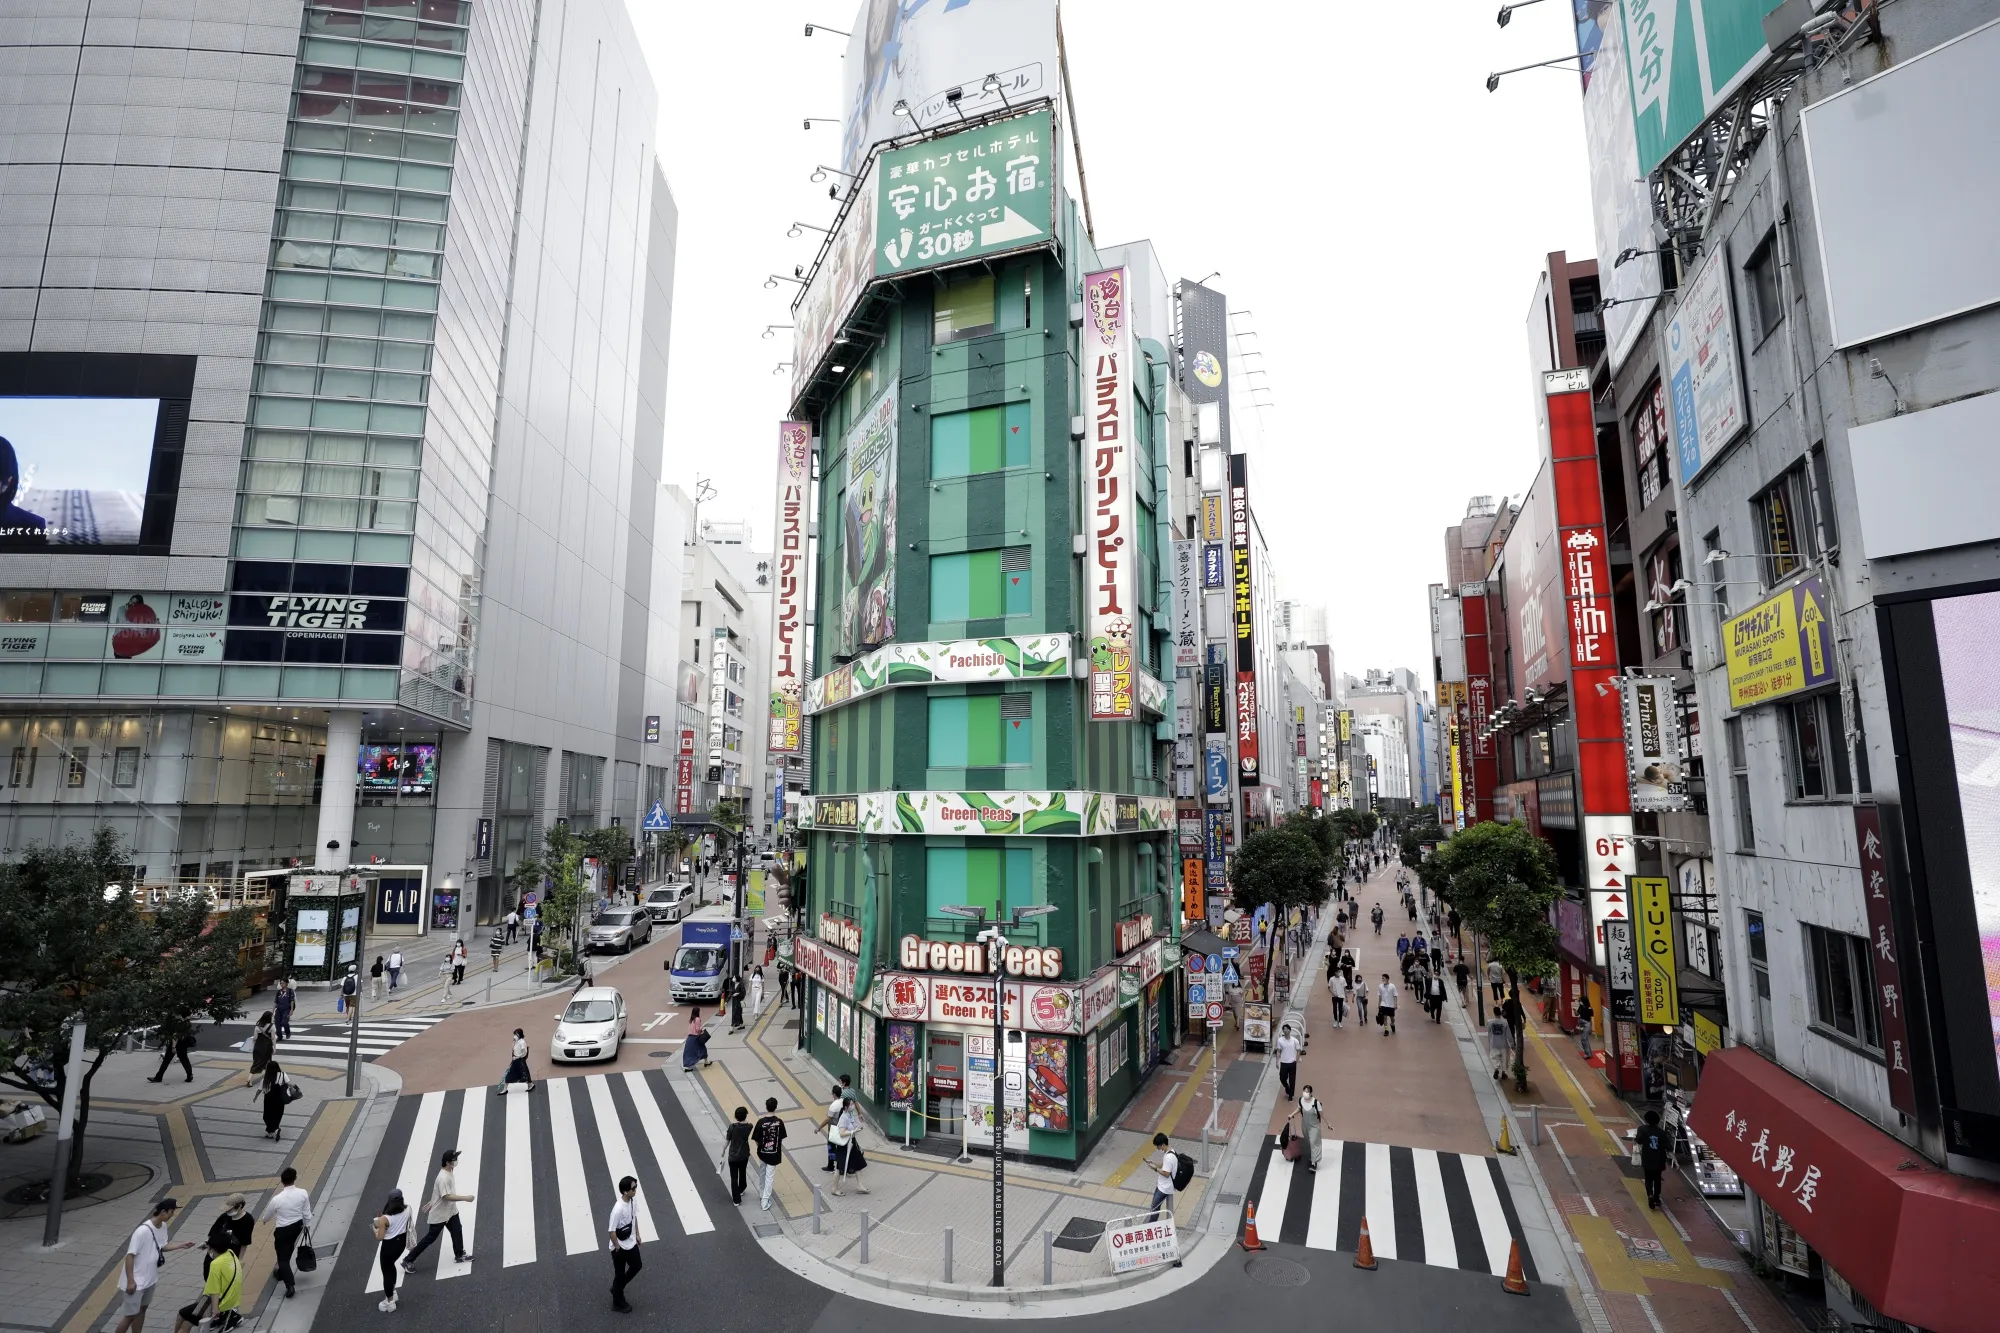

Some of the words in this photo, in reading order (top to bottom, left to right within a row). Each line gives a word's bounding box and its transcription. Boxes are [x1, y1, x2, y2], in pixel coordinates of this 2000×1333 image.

[919, 74, 1030, 124] ハッーール
[890, 131, 1038, 179] 豪華カプセルホテル
[888, 154, 1040, 221] 安心お宿
[919, 207, 999, 235] ガードくぐって
[917, 229, 974, 260] 30秒
[1546, 370, 1582, 382] ワールド
[1568, 381, 1587, 391] ビル
[1676, 380, 1691, 466] アイシティ
[0, 527, 69, 536] 上げてくれたから
[1232, 487, 1247, 545] 驚安の殿堂
[1568, 553, 1579, 596] TAITO
[269, 597, 370, 612] FLYING
[1178, 551, 1196, 647] 喜多方ラーメン蔵
[1235, 548, 1251, 639] ドン・キホーテ
[1577, 551, 1607, 662] GAME
[172, 610, 224, 622] Shinjuku!
[266, 611, 367, 629] TIGER
[1734, 601, 1781, 646] ムラサキスポーツ
[1804, 606, 1818, 623] GO!
[286, 631, 344, 640] COPENHAGEN
[1573, 601, 1585, 662] STATION
[1735, 639, 1762, 659] MURASAKI
[1762, 628, 1785, 644] SPORTS
[949, 653, 1006, 668] Pachislo
[1810, 627, 1821, 670] 100m
[1770, 672, 1792, 691] 徒歩1分
[1639, 693, 1654, 752] Princess
[1211, 755, 1223, 789] アース
[1668, 784, 1682, 794] 3F
[816, 799, 856, 825] レア台の聖地
[941, 806, 978, 822] Green
[981, 807, 1012, 822] Peas
[480, 821, 488, 857] GAP
[1596, 838, 1624, 857] 6F
[384, 889, 418, 913] GAP
[819, 913, 840, 946] Green
[840, 921, 860, 955] Peas
[796, 938, 817, 975] Green
[818, 948, 838, 987] Peas
[900, 935, 984, 973] Green
[988, 939, 1062, 979] Peas
[1862, 828, 1885, 899] 食堂
[1875, 925, 1908, 1074] 長野屋
[893, 980, 916, 1006] 新
[1654, 978, 1664, 1011] SHOP
[942, 1002, 977, 1017] Green
[981, 1005, 1010, 1021] Pes
[1210, 1006, 1219, 1016] 30
[931, 1037, 946, 1046] Green
[947, 1038, 960, 1047] Peas
[934, 1077, 947, 1085] Green
[1725, 1109, 1748, 1143] 食堂
[1751, 1128, 1822, 1214] 長野屋
[1125, 1224, 1172, 1245] 車両通行止
